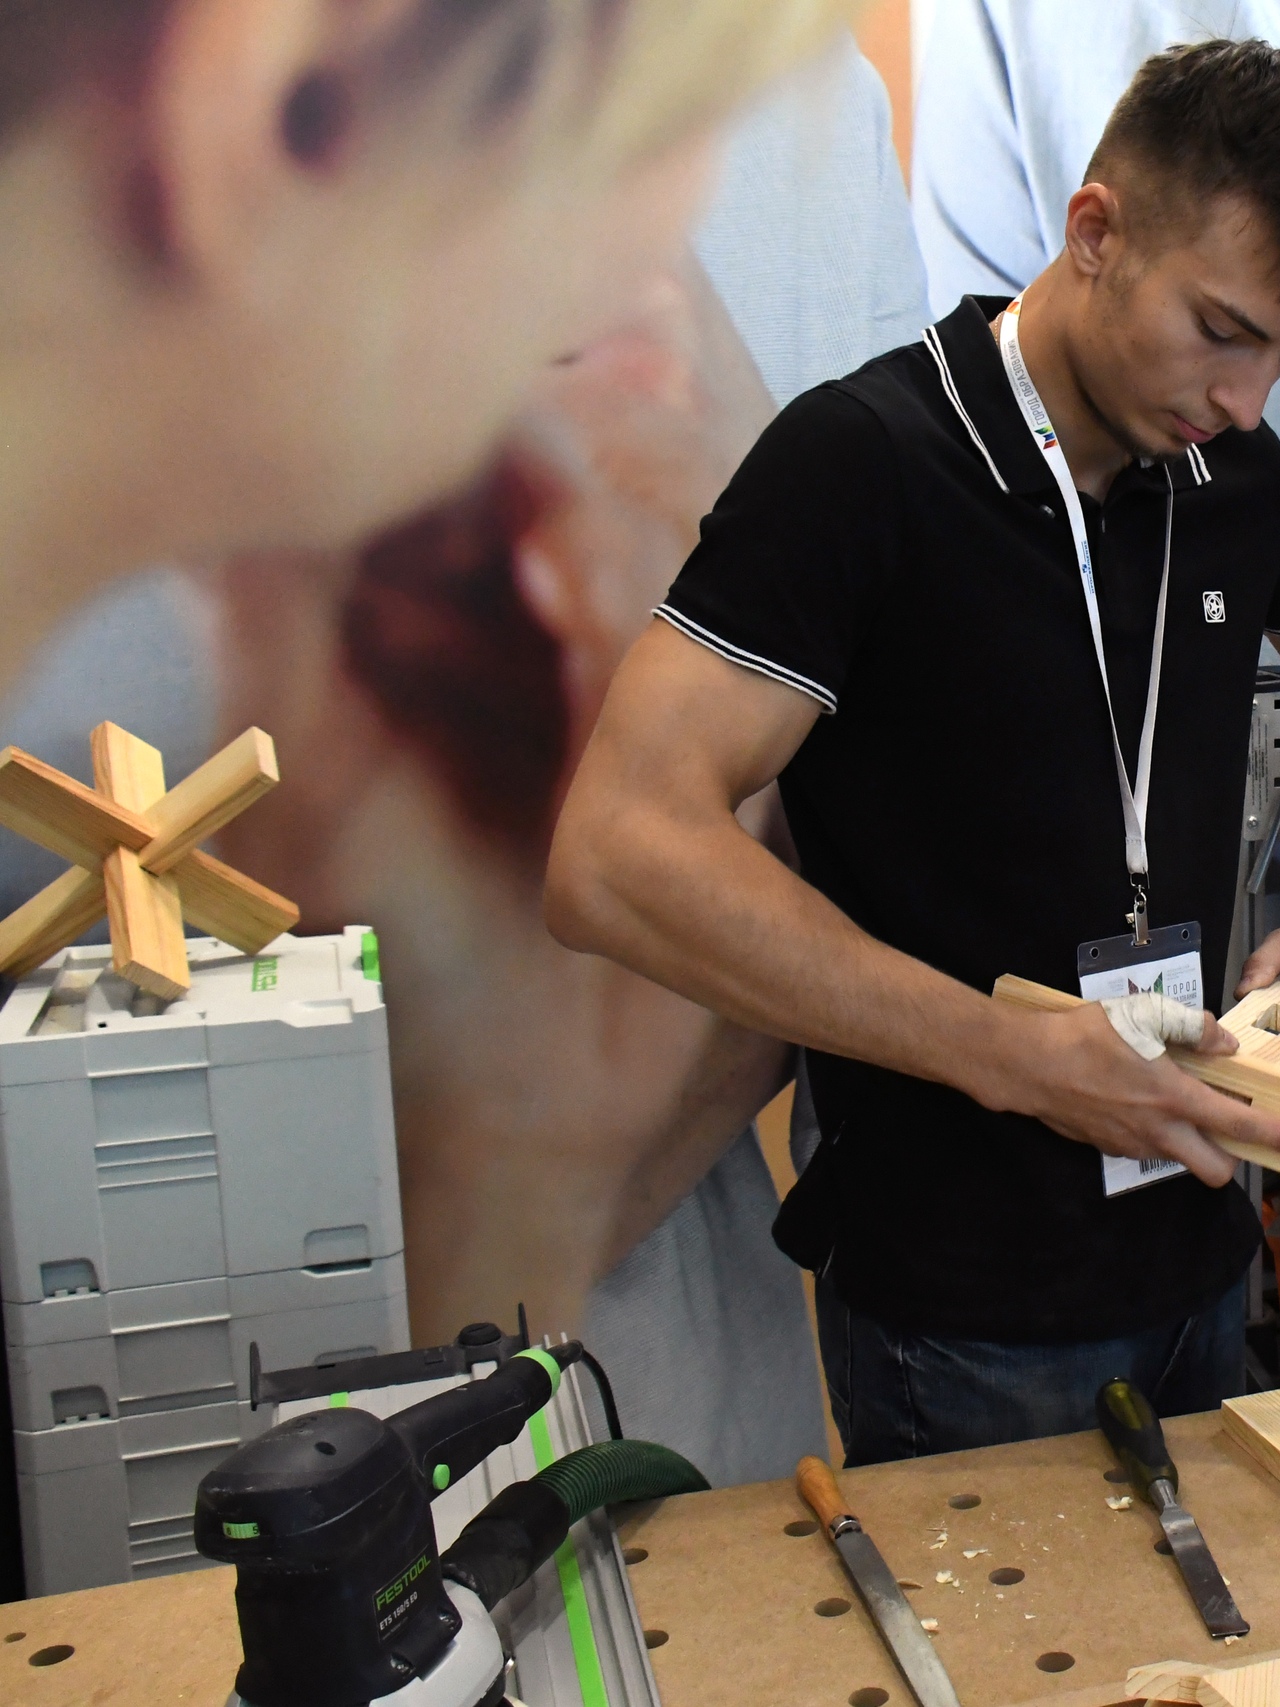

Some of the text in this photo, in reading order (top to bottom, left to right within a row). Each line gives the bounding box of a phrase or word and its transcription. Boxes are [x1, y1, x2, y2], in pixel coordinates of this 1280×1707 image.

[1007, 339, 1034, 398] ОБРАЗОВАНИЯ
[1027, 396, 1048, 426] ГОРОД
[1166, 979, 1197, 997] ГОРОД
[375, 1554, 432, 1611] FESTOOL
[379, 1613, 394, 1631] ETS
